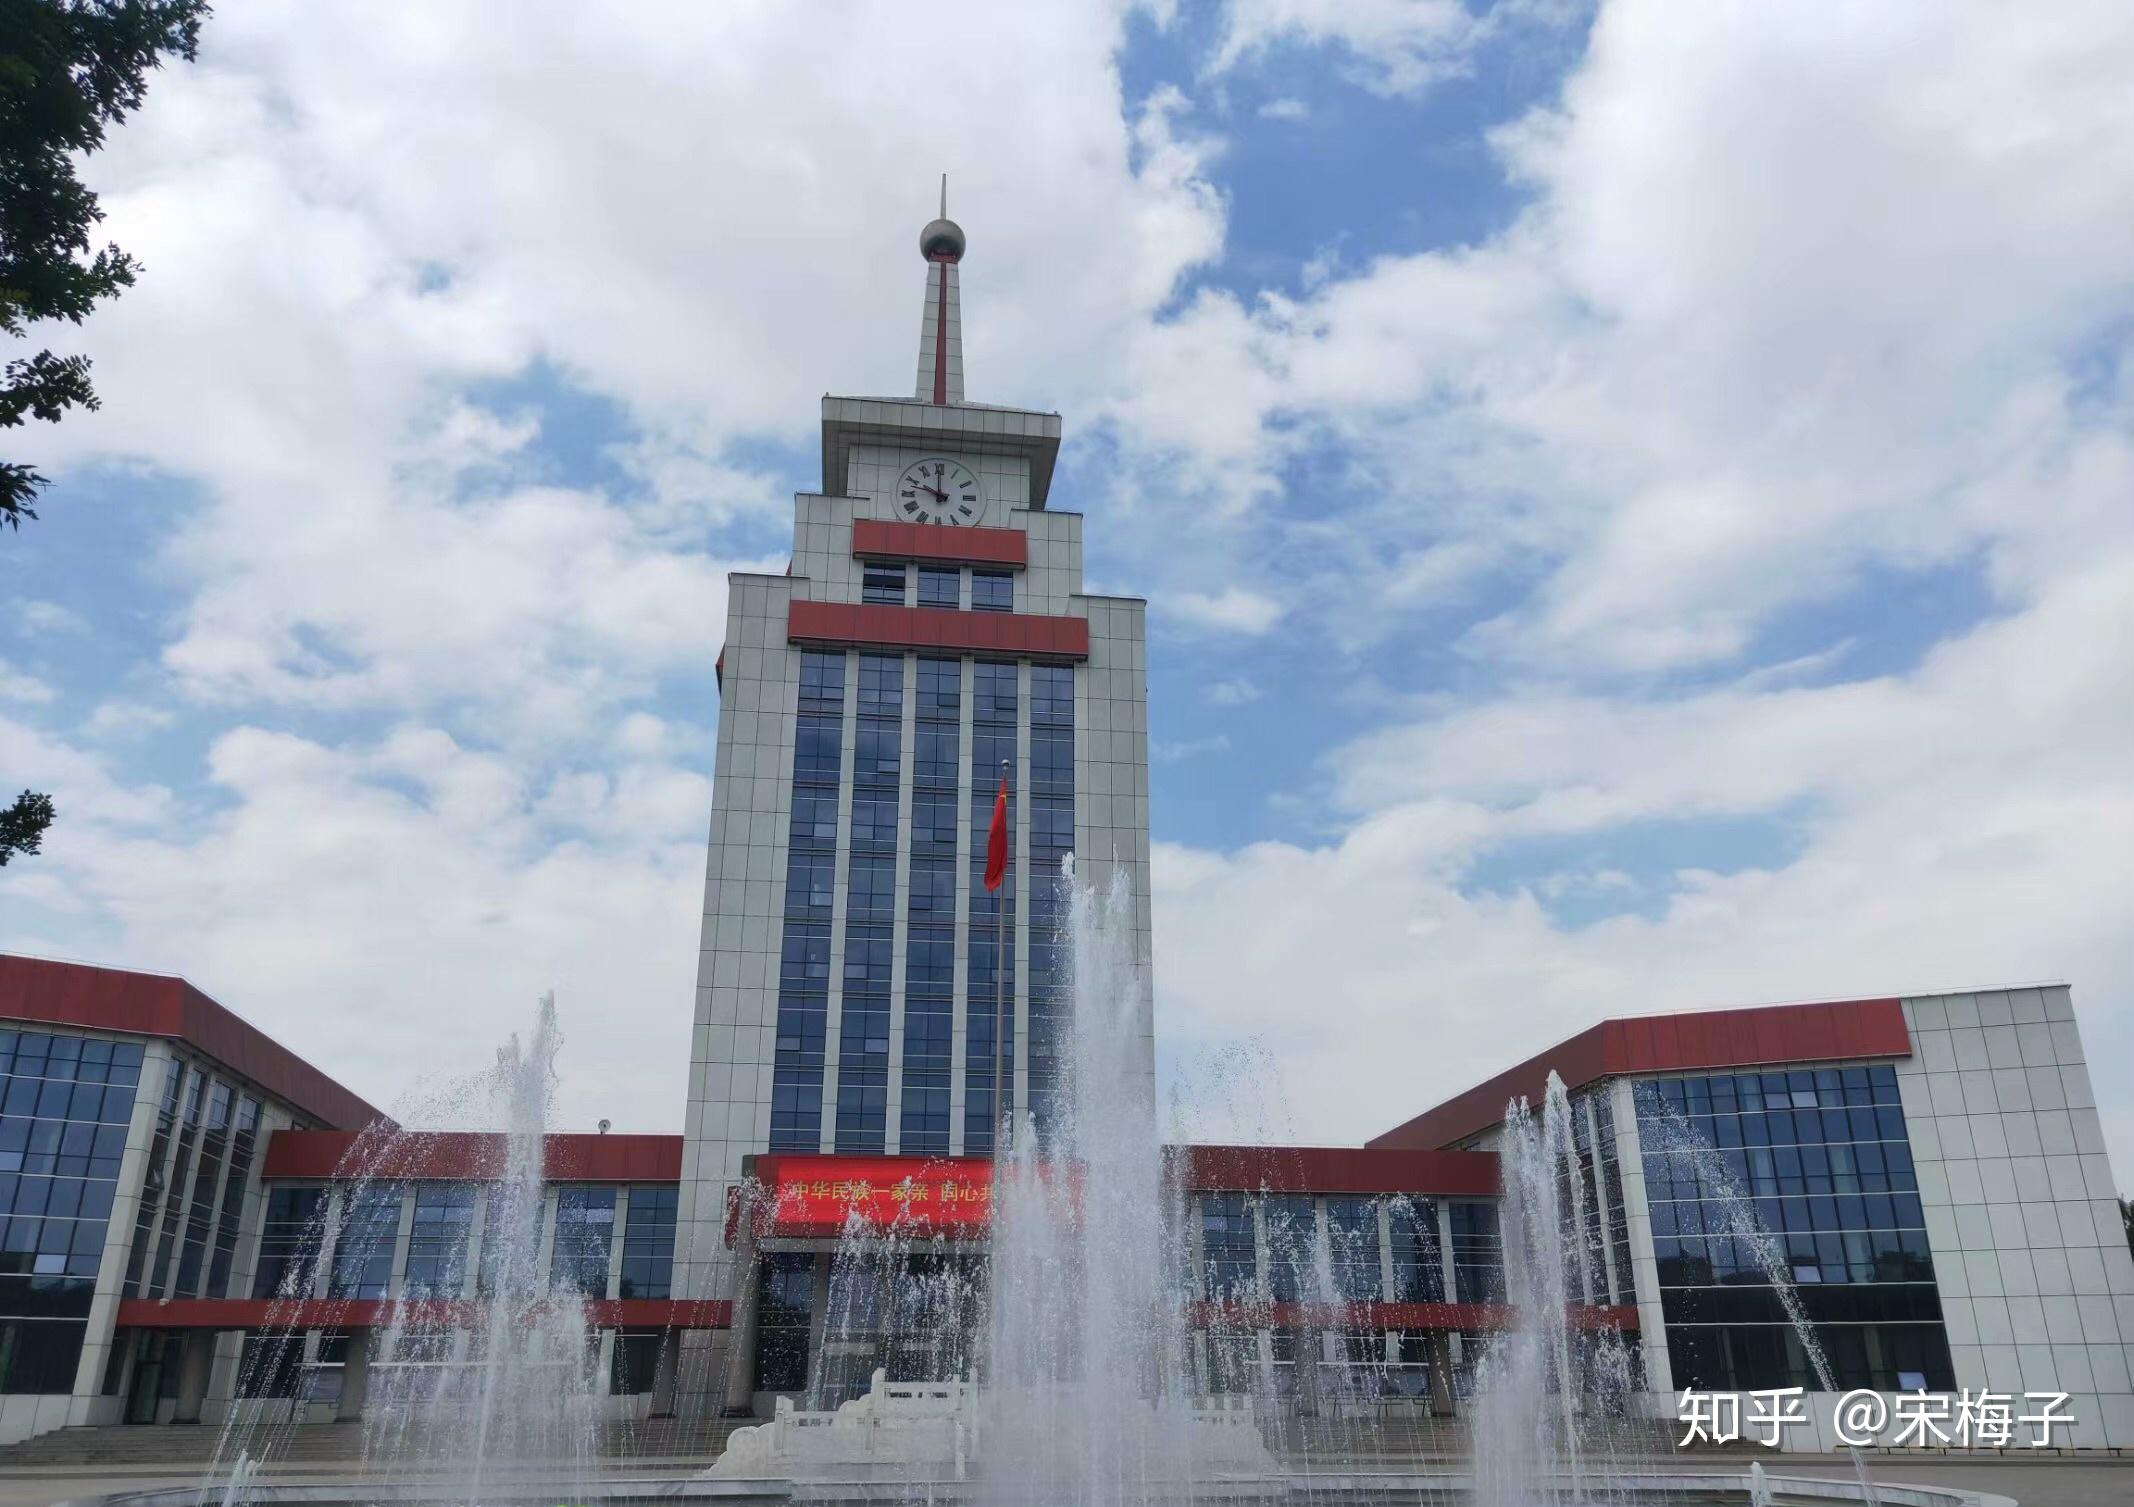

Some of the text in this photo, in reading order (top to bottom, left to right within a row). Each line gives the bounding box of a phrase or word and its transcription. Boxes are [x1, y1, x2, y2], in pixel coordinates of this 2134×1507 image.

[792, 1180, 929, 1201] 中华民族一家亲
